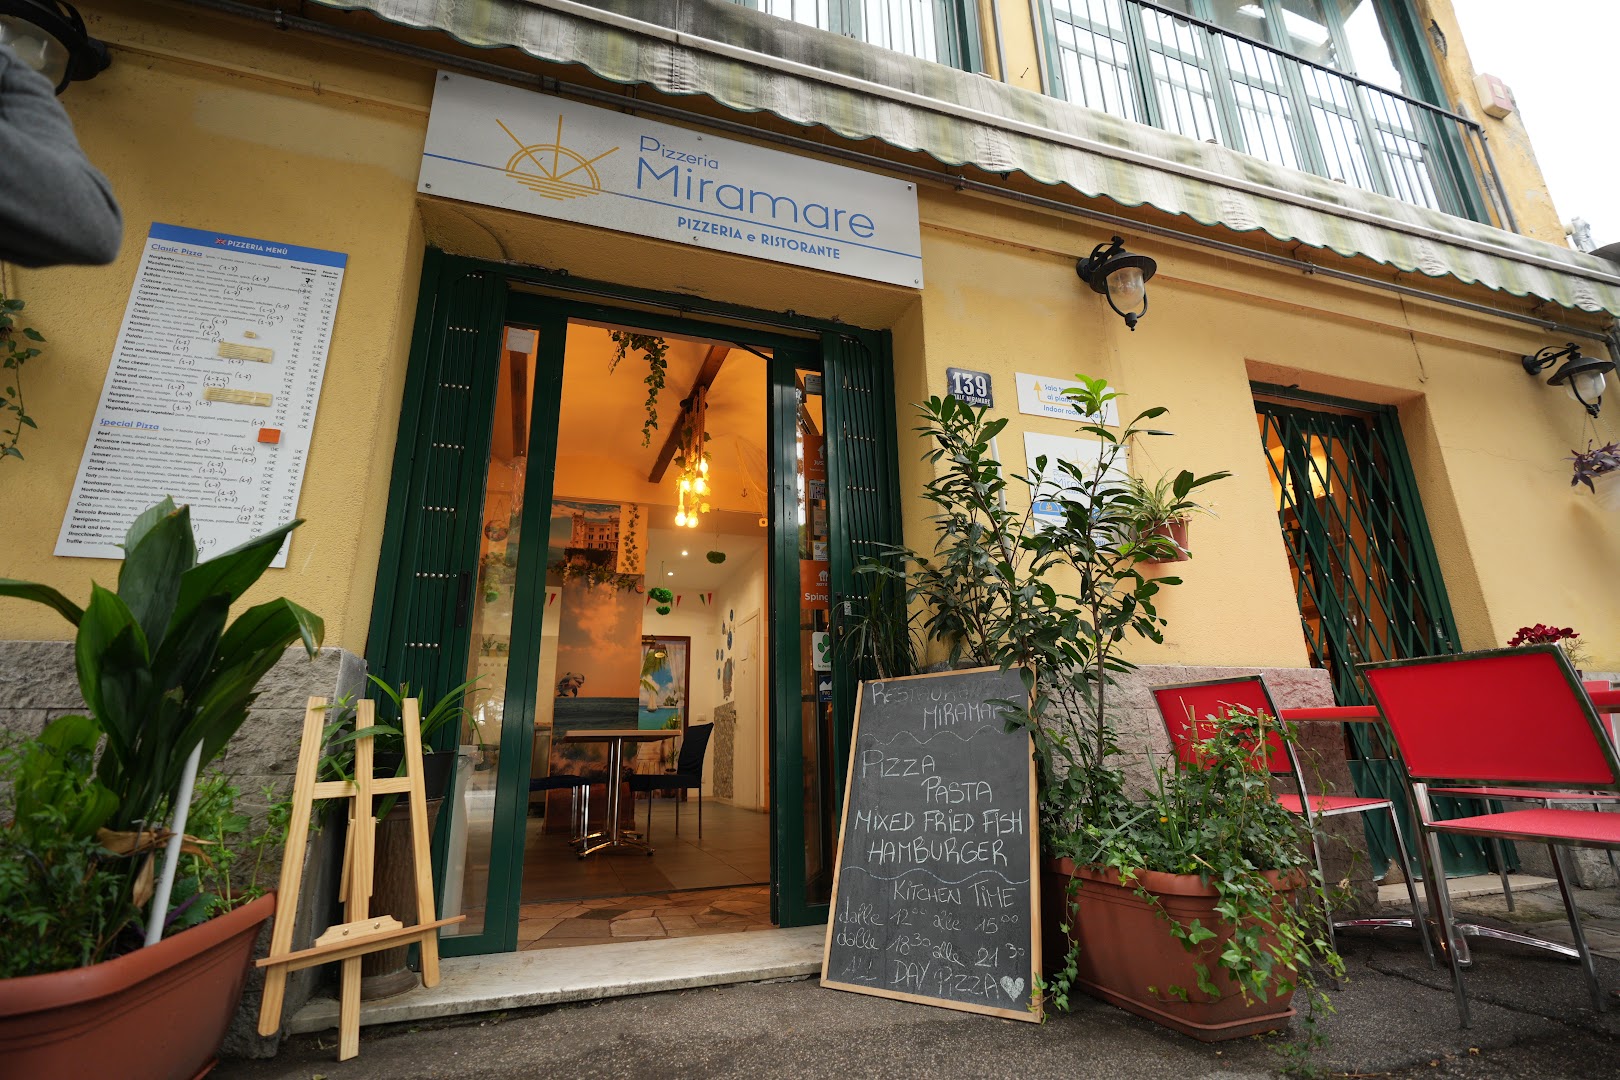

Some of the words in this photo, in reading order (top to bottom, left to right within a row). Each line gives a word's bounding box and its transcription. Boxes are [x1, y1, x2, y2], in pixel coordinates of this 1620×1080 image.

[639, 135, 719, 170] Pizzeria
[637, 157, 875, 238] Miramare
[150, 243, 178, 253] Classic
[180, 248, 203, 256] Pizza
[227, 239, 264, 251] PIZZERIA
[265, 245, 288, 254] MENÙ
[677, 216, 742, 240] PIZZERIA
[746, 233, 756, 242] e
[761, 233, 840, 260] RISTORANTE
[953, 371, 988, 398] 139
[1045, 384, 1058, 392] Sala
[966, 395, 991, 407] MIRAMARE
[1043, 404, 1064, 413] Indoor
[99, 418, 133, 428] Special
[135, 421, 160, 429] Pizza
[1053, 477, 1107, 493] Mirare
[921, 776, 993, 804] PASTA
[867, 836, 1008, 867] HAMBURGER
[838, 896, 884, 926] dalle
[836, 926, 880, 950] dalle
[932, 941, 965, 967] alle
[889, 959, 931, 991] DAY
